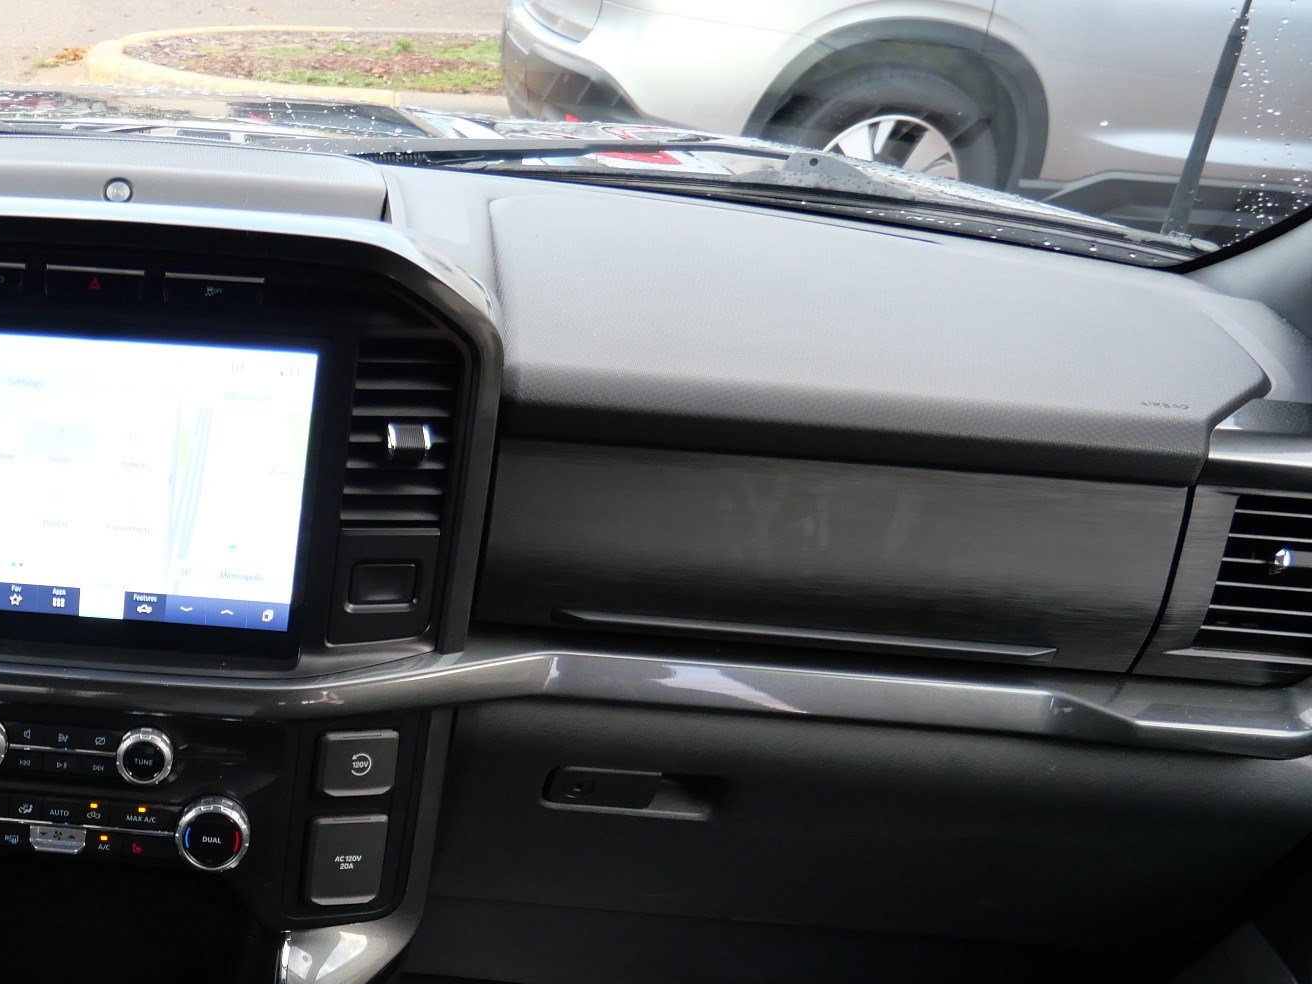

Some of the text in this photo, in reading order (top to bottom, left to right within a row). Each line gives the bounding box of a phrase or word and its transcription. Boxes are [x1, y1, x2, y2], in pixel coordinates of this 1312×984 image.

[11, 584, 22, 593] Fav
[52, 587, 66, 596] Apps
[133, 594, 157, 603] Features
[134, 758, 154, 766] TUNE
[49, 809, 70, 817] AUTO
[126, 815, 157, 824] MAX A/C
[202, 836, 222, 844] DUAL
[98, 843, 110, 851] A/C
[335, 855, 344, 863] AC
